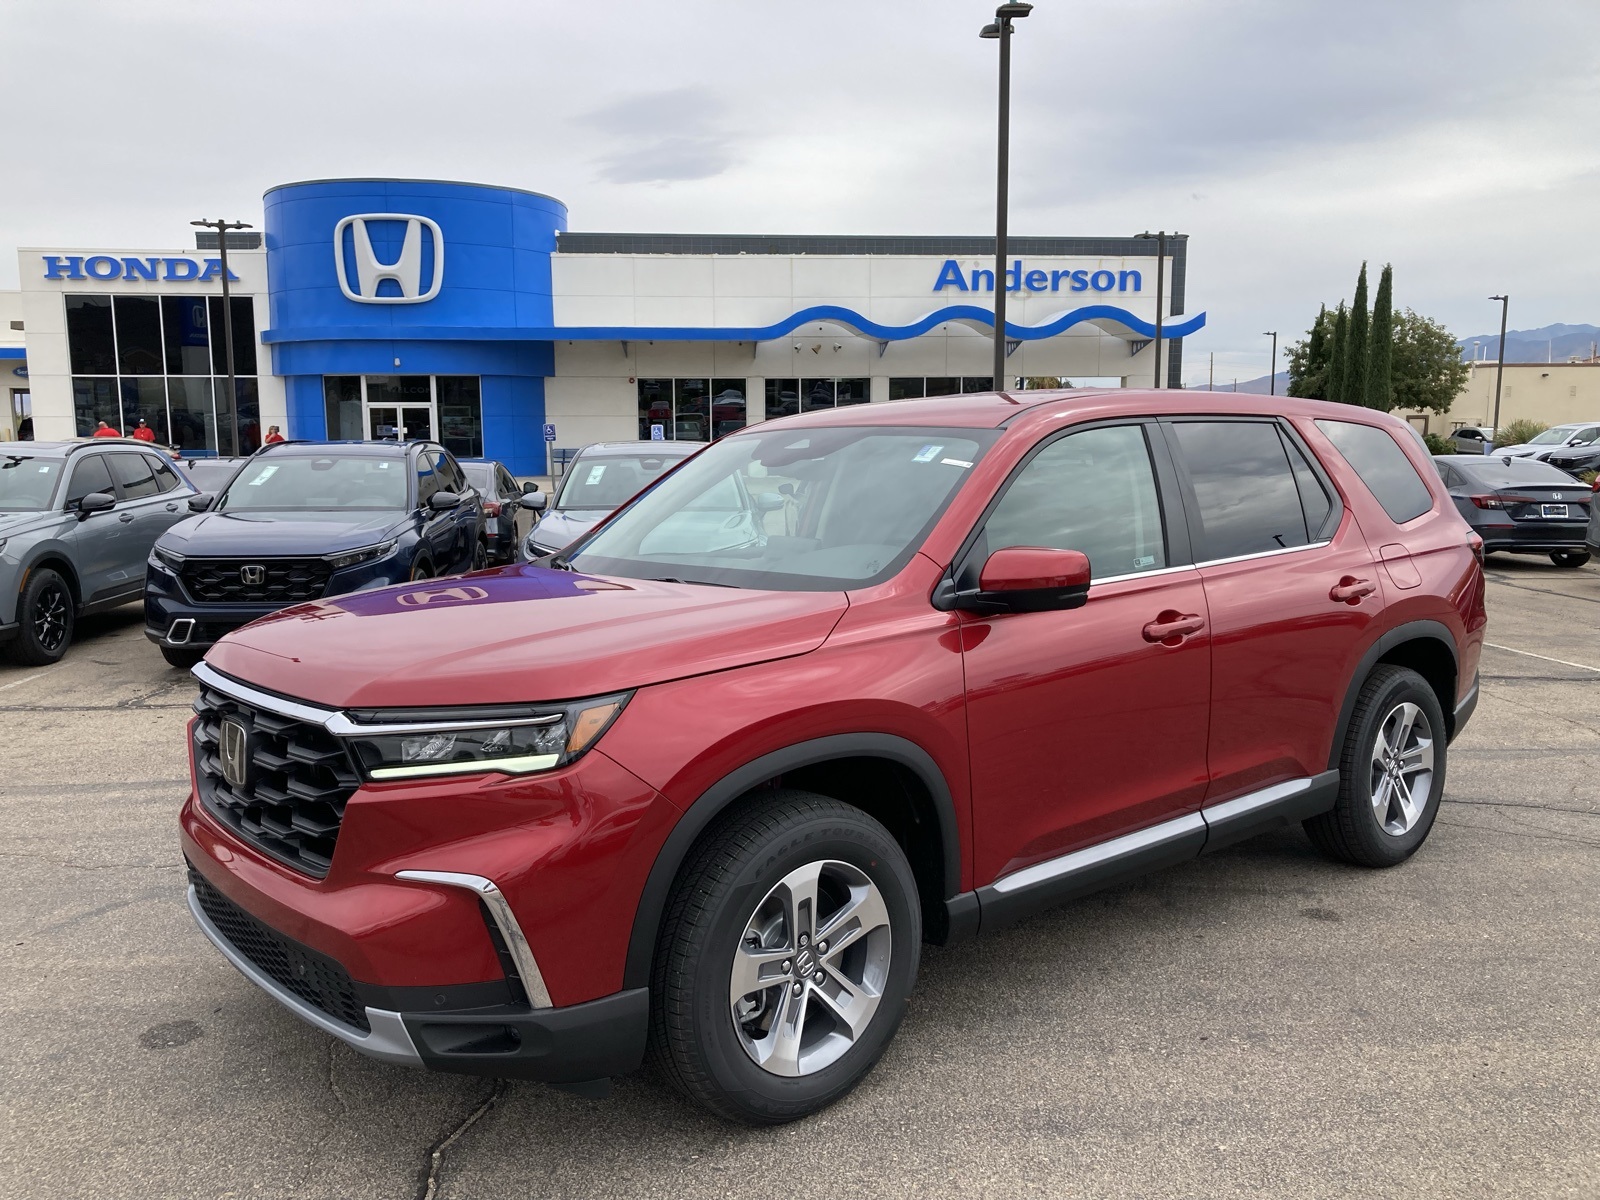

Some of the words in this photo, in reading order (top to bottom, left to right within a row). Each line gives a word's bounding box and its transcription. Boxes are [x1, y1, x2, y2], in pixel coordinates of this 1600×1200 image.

[42, 256, 239, 282] HONDA
[932, 260, 1142, 292] Anderson
[755, 832, 815, 879] EAGLE
